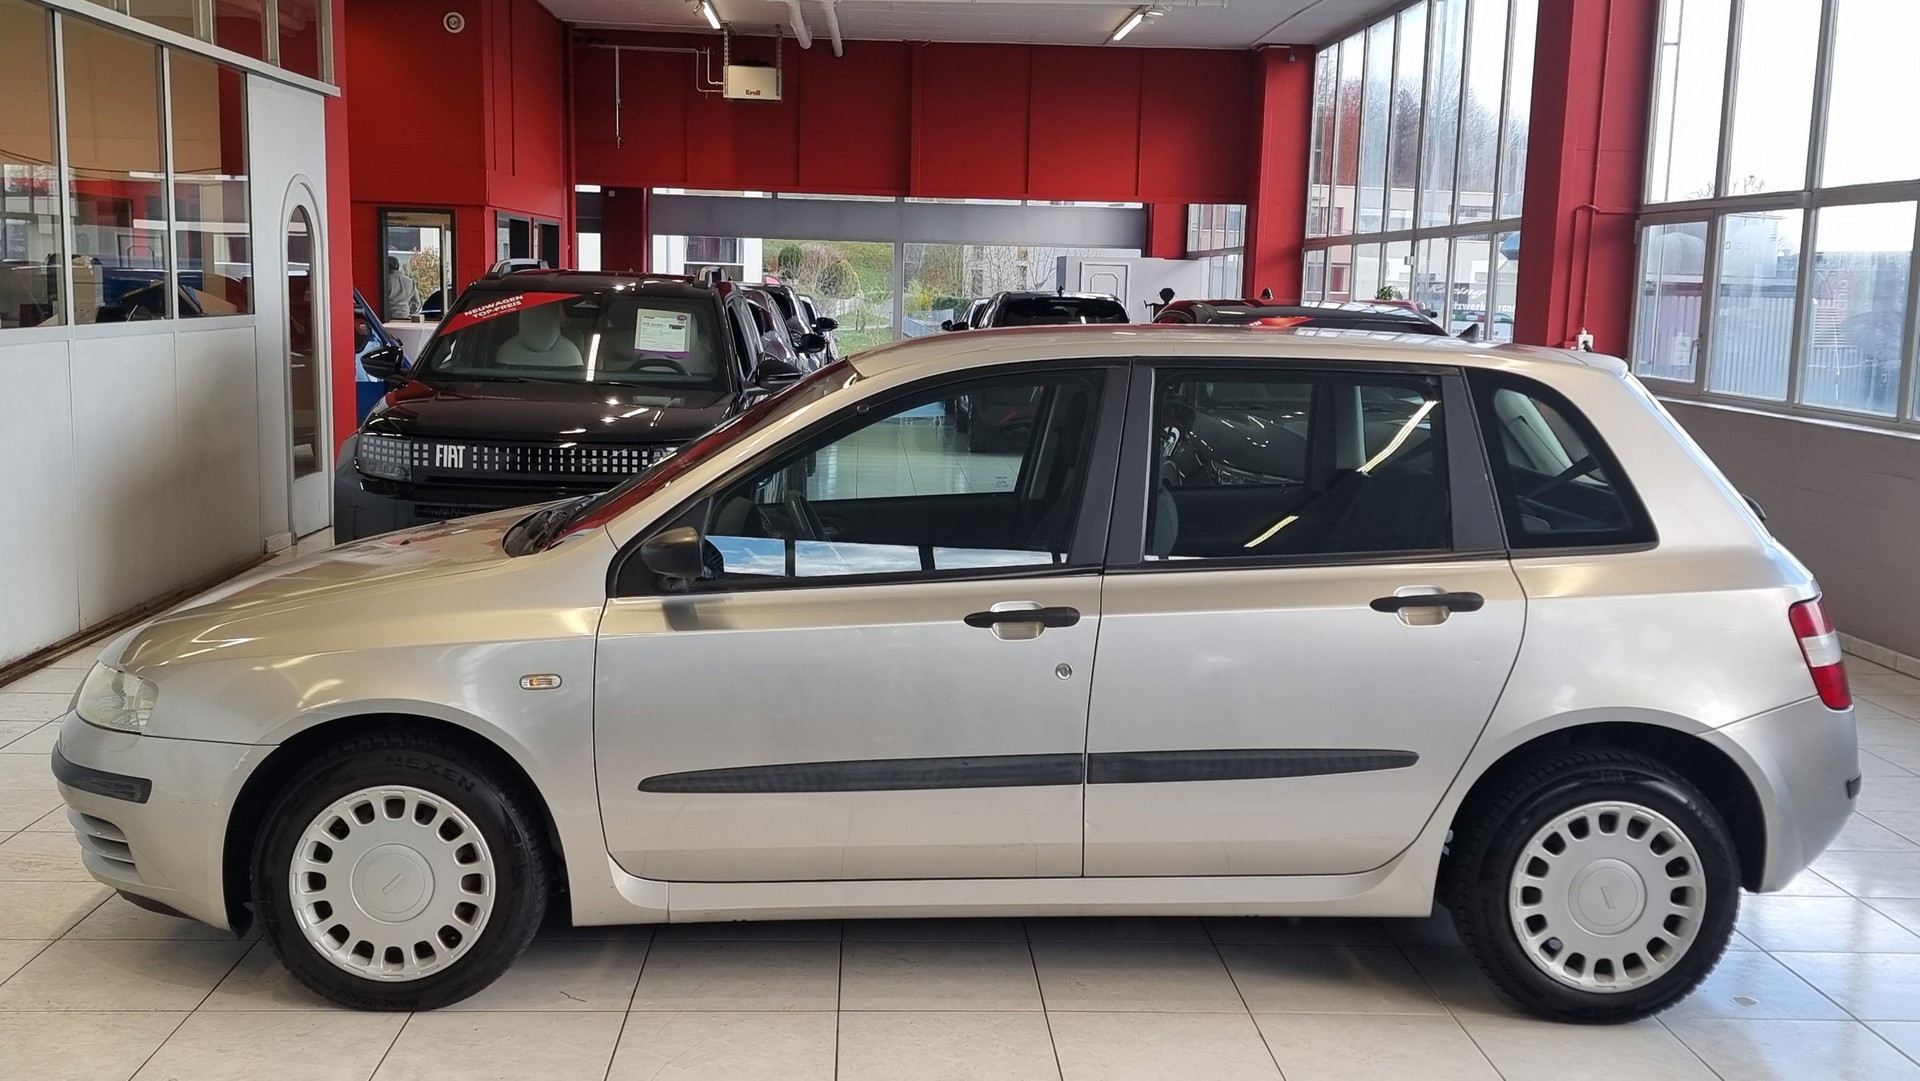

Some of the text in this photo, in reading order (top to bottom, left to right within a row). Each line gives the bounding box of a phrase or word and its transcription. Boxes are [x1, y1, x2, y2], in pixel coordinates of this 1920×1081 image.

[464, 295, 524, 316] NEUWAGEN
[472, 301, 522, 318] TOP-PREIS
[435, 444, 466, 468] FIAT
[385, 755, 476, 793] NEXEN
